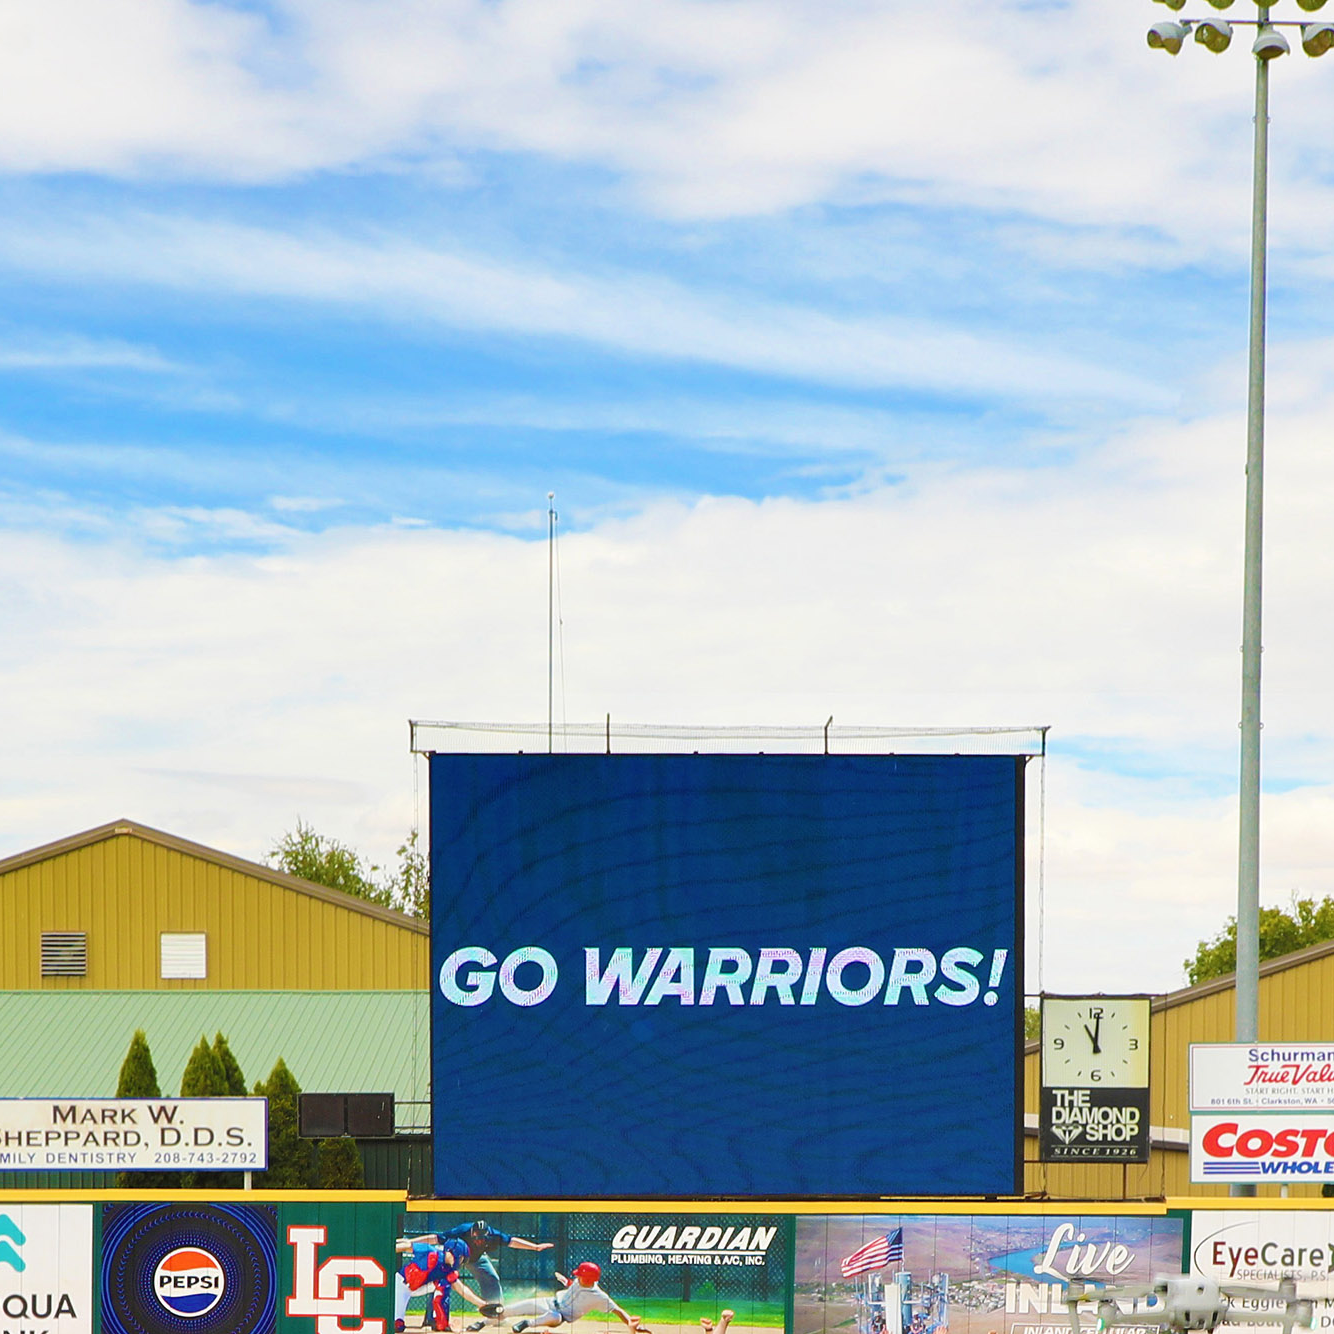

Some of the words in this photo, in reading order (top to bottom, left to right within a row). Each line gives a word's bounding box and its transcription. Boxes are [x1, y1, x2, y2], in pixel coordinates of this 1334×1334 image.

[439, 946, 558, 1007] GO
[583, 946, 1009, 1007] WARRIORS!
[1052, 1089, 1091, 1107] THE
[1245, 1087, 1269, 1095] START
[1301, 1087, 1324, 1095] START
[148, 1105, 185, 1126] W.
[1051, 1107, 1141, 1125] DIAMOND
[161, 1127, 253, 1148] D.D.S.
[1085, 1124, 1139, 1142] SHOP
[45, 1152, 138, 1165] DENTISTRY
[154, 1152, 258, 1165] 208-743-2792
[1054, 1147, 1100, 1157] SINCE
[1104, 1147, 1138, 1157] 1926
[612, 1225, 777, 1250] GUARDIAN
[611, 1254, 666, 1266] PLUMBING,
[668, 1254, 712, 1265] HEATING
[714, 1254, 721, 1265] &
[745, 1254, 766, 1266] INC.
[1034, 1223, 1136, 1281] Live
[1212, 1241, 1325, 1278] EyeCare
[159, 1275, 219, 1289] PEPSI
